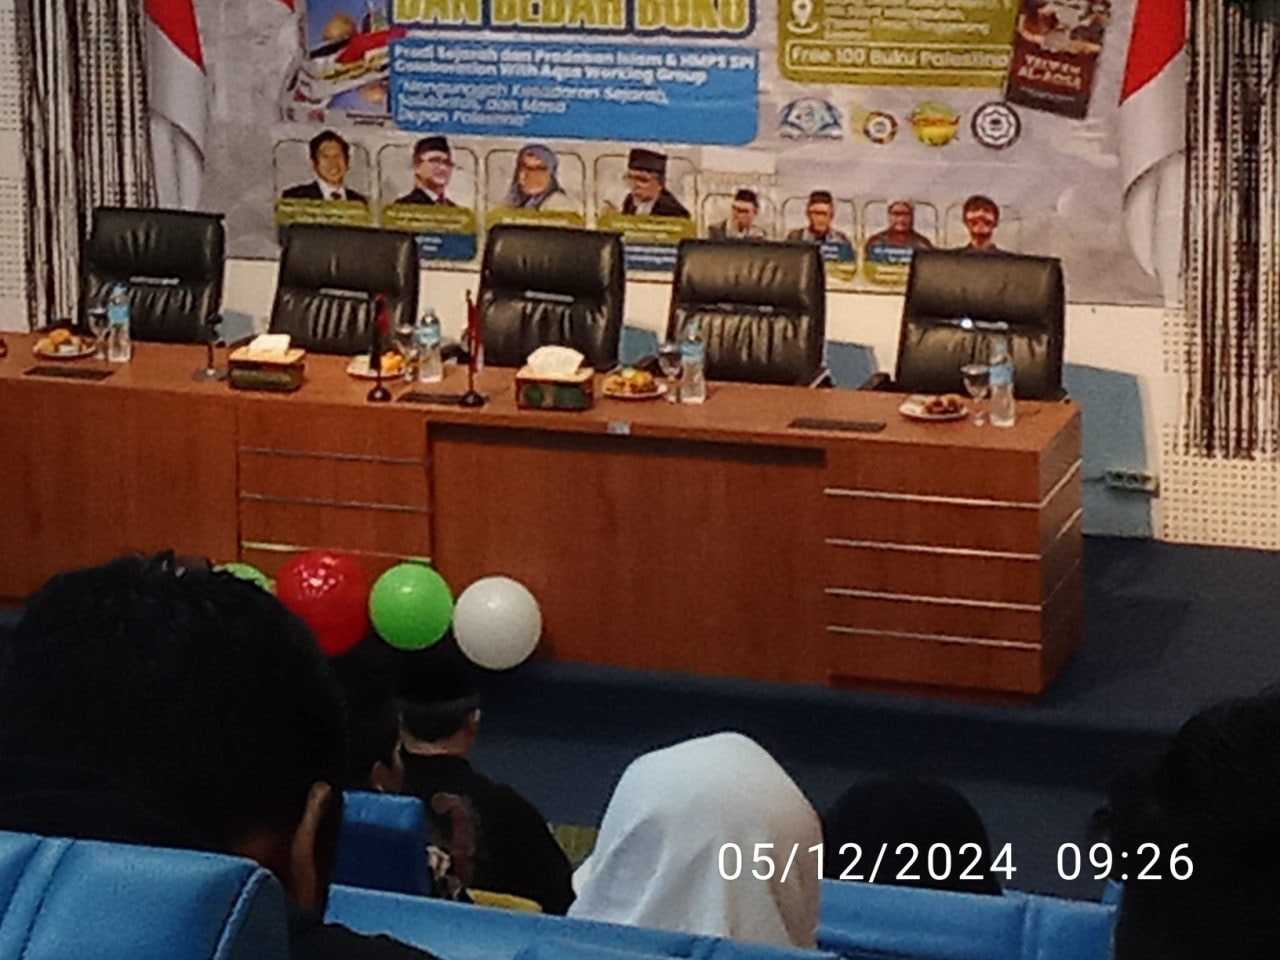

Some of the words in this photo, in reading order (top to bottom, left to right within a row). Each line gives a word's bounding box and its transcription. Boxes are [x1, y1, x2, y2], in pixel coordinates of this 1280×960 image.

[617, 51, 663, 66] Islam
[791, 46, 832, 64] Free
[836, 47, 866, 65] 100
[870, 48, 917, 67] Buku
[584, 66, 654, 85] Working
[656, 68, 708, 86] Group
